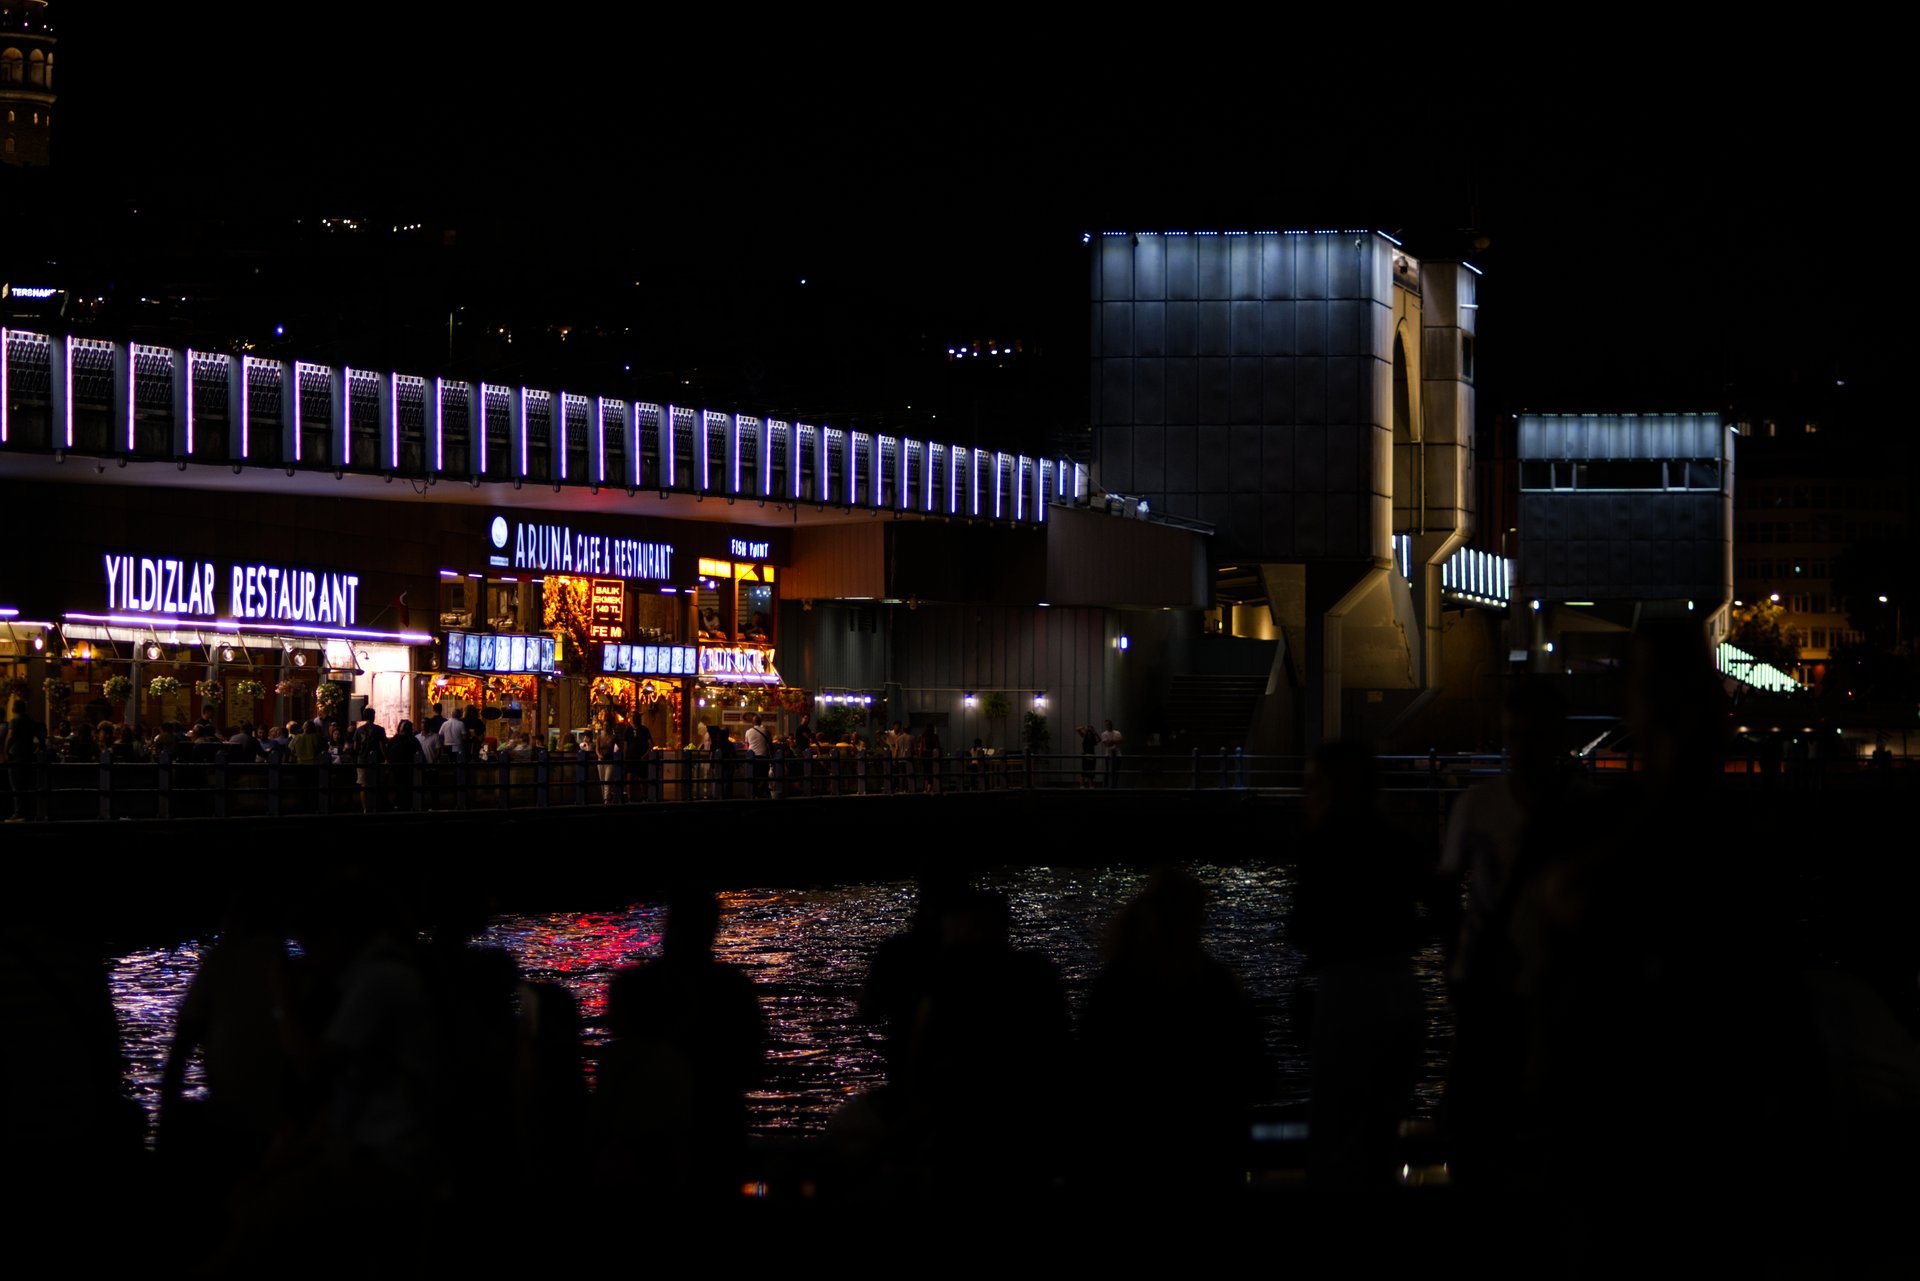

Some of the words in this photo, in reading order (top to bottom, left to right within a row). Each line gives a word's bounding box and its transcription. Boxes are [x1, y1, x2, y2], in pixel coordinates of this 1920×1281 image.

[515, 522, 572, 571] ARUNA
[576, 533, 600, 574] CAFE
[604, 536, 610, 575] &
[614, 538, 671, 580] RESTAURANT
[731, 538, 747, 557] FISH
[749, 541, 769, 558] POINT
[105, 554, 215, 615] YILDIZLAR
[231, 564, 359, 627] RESTAURANT
